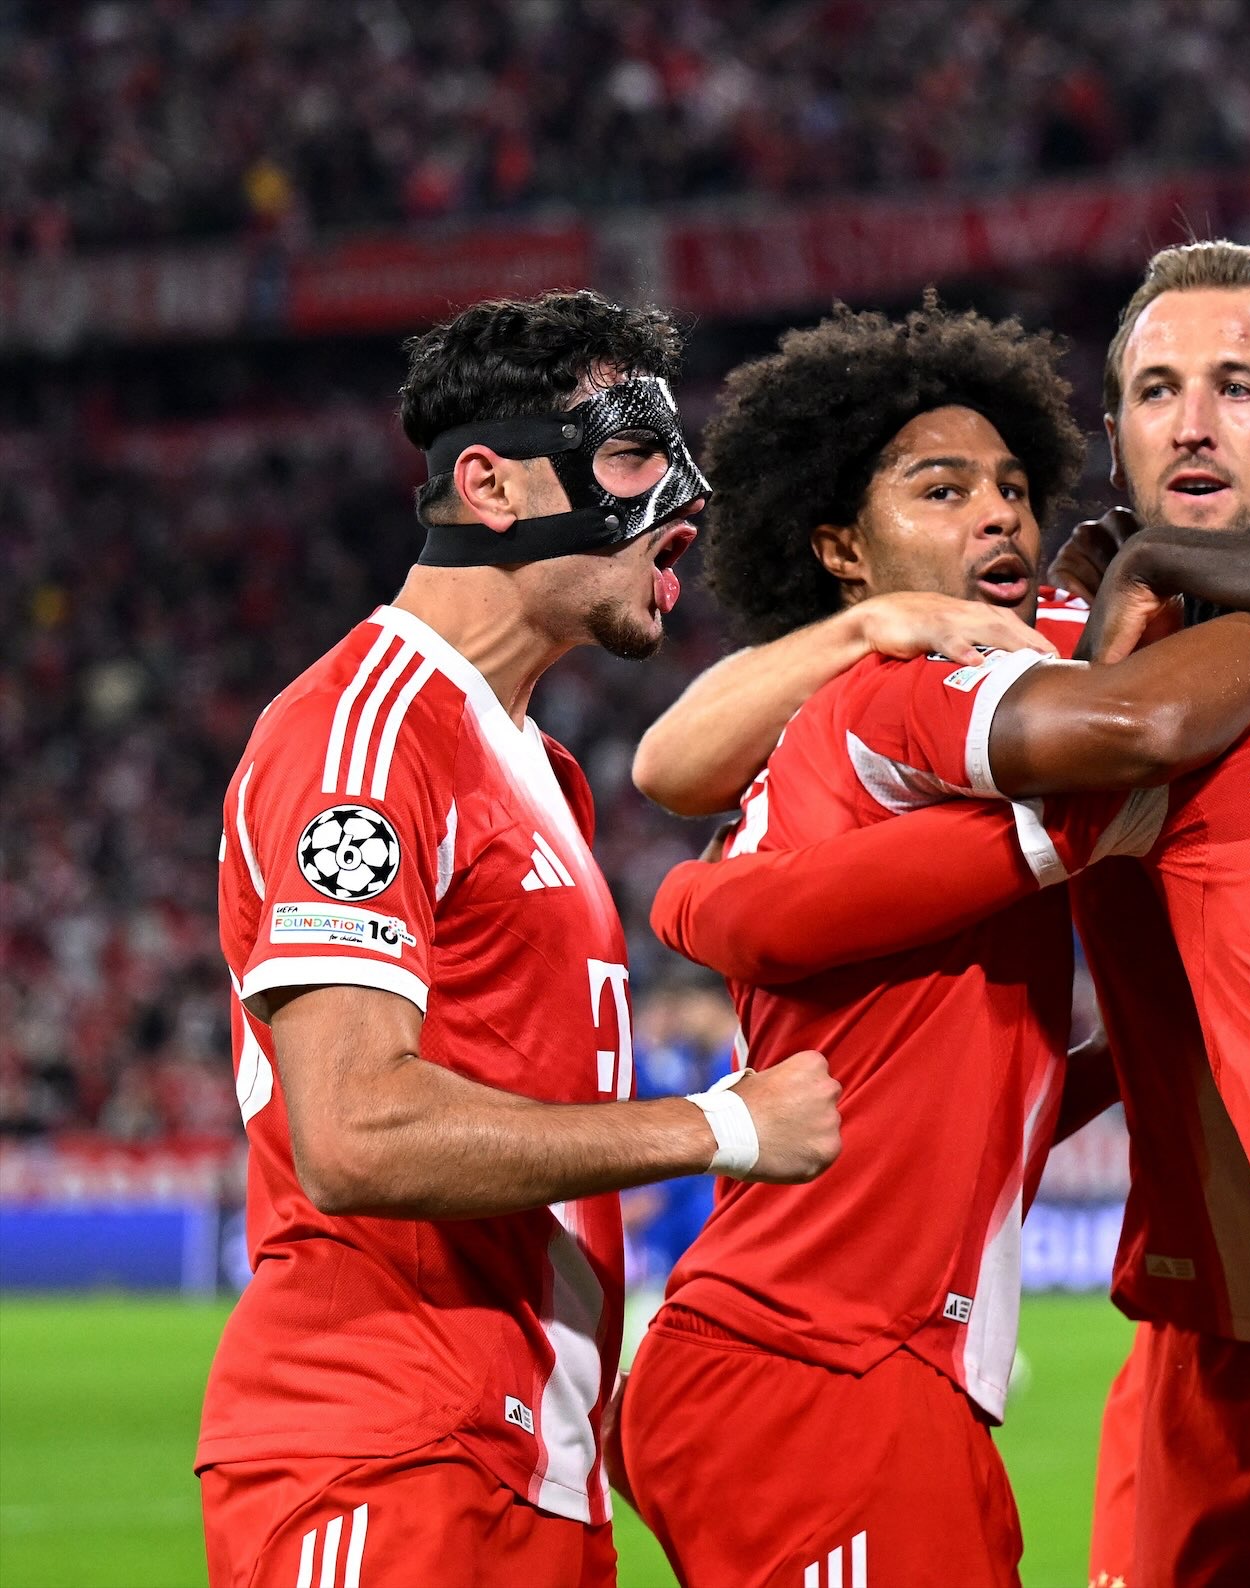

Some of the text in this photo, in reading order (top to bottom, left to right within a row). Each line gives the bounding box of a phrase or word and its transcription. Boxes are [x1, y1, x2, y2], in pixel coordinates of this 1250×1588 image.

[335, 834, 362, 871] 6
[276, 906, 298, 914] UEFA
[328, 934, 363, 943] for children
